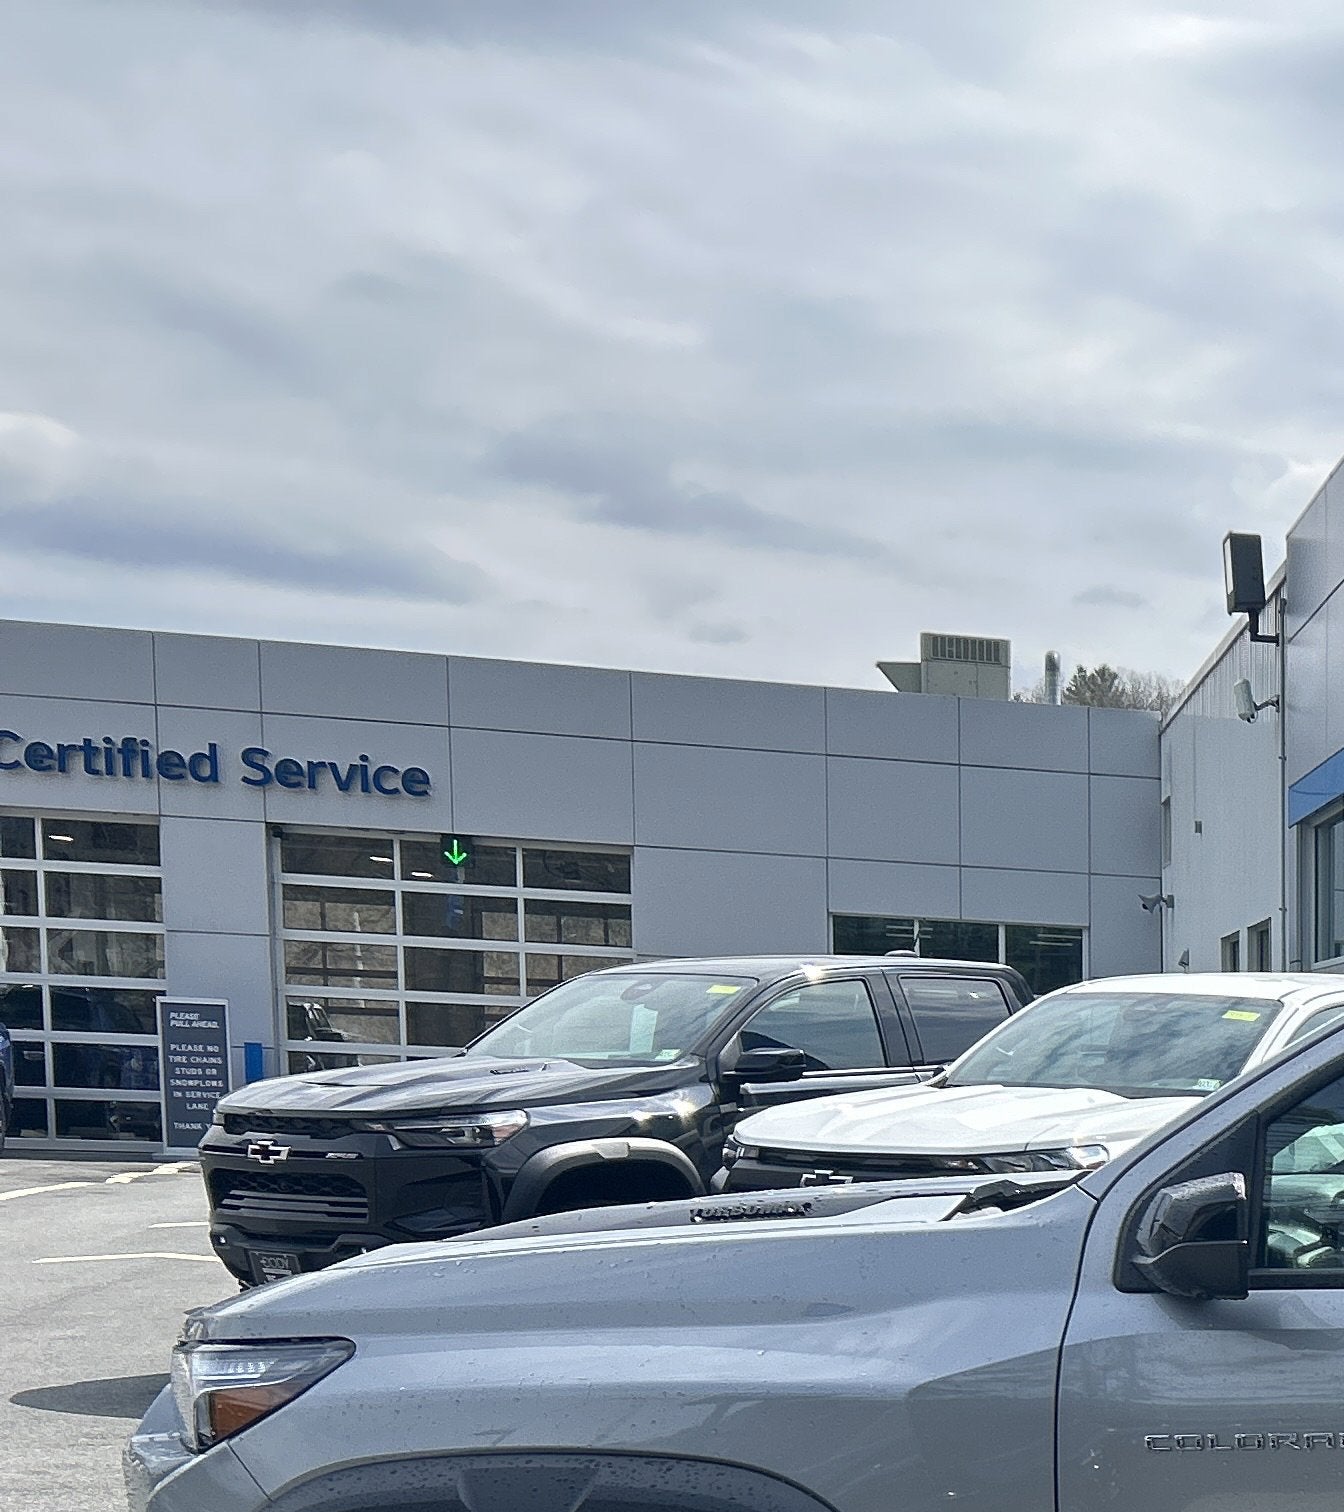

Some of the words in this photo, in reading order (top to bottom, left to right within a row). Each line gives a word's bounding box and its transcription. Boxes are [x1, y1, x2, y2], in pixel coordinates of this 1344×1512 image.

[0, 729, 220, 783] Certified
[241, 746, 432, 797] Service
[169, 1012, 200, 1020] PLEASE
[170, 1020, 190, 1028] PULL
[170, 1043, 205, 1053] PLEASE
[206, 1045, 220, 1053] NO
[168, 1055, 188, 1063] TIRE
[190, 1056, 222, 1065] CHAINS
[175, 1067, 203, 1075] STUDS
[205, 1068, 217, 1076] OR
[169, 1079, 224, 1088] SNOWPLOWS
[185, 1091, 221, 1099] SERVICE
[185, 1103, 210, 1111] LANE
[173, 1121, 203, 1130] THANK
